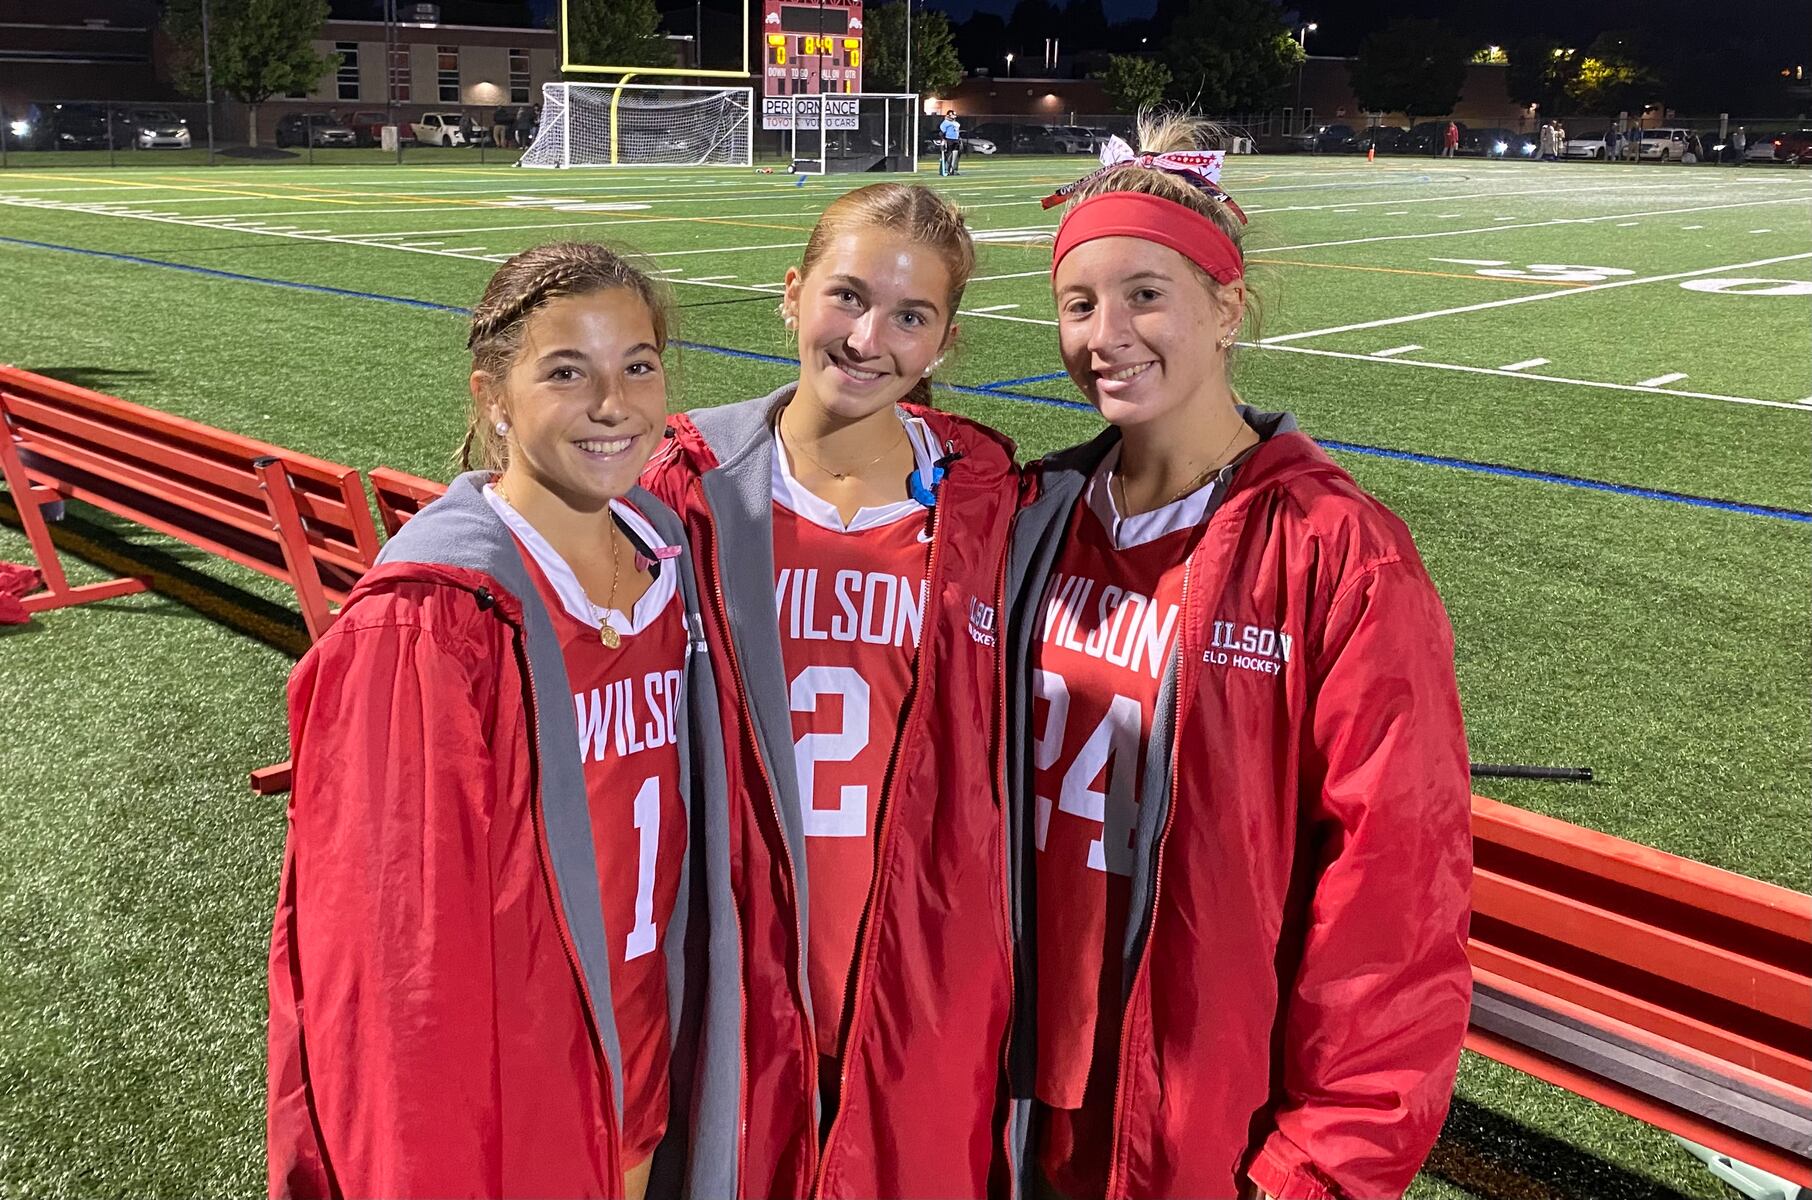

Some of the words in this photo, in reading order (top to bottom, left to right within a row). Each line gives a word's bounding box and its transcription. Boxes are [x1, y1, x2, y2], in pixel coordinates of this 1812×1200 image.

[777, 46, 786, 64] 0
[850, 50, 859, 67] 0
[768, 67, 786, 77] DOWN
[791, 68, 799, 77] TO
[767, 118, 799, 127] TOYOA
[806, 119, 833, 127] VOO
[834, 119, 856, 127] CARS
[1033, 573, 1180, 680] WILSON
[1203, 650, 1228, 665] ELD
[1233, 654, 1281, 675] HOCKEY
[574, 669, 683, 764] WILSO
[789, 665, 870, 837] 2
[624, 775, 660, 962] 1
